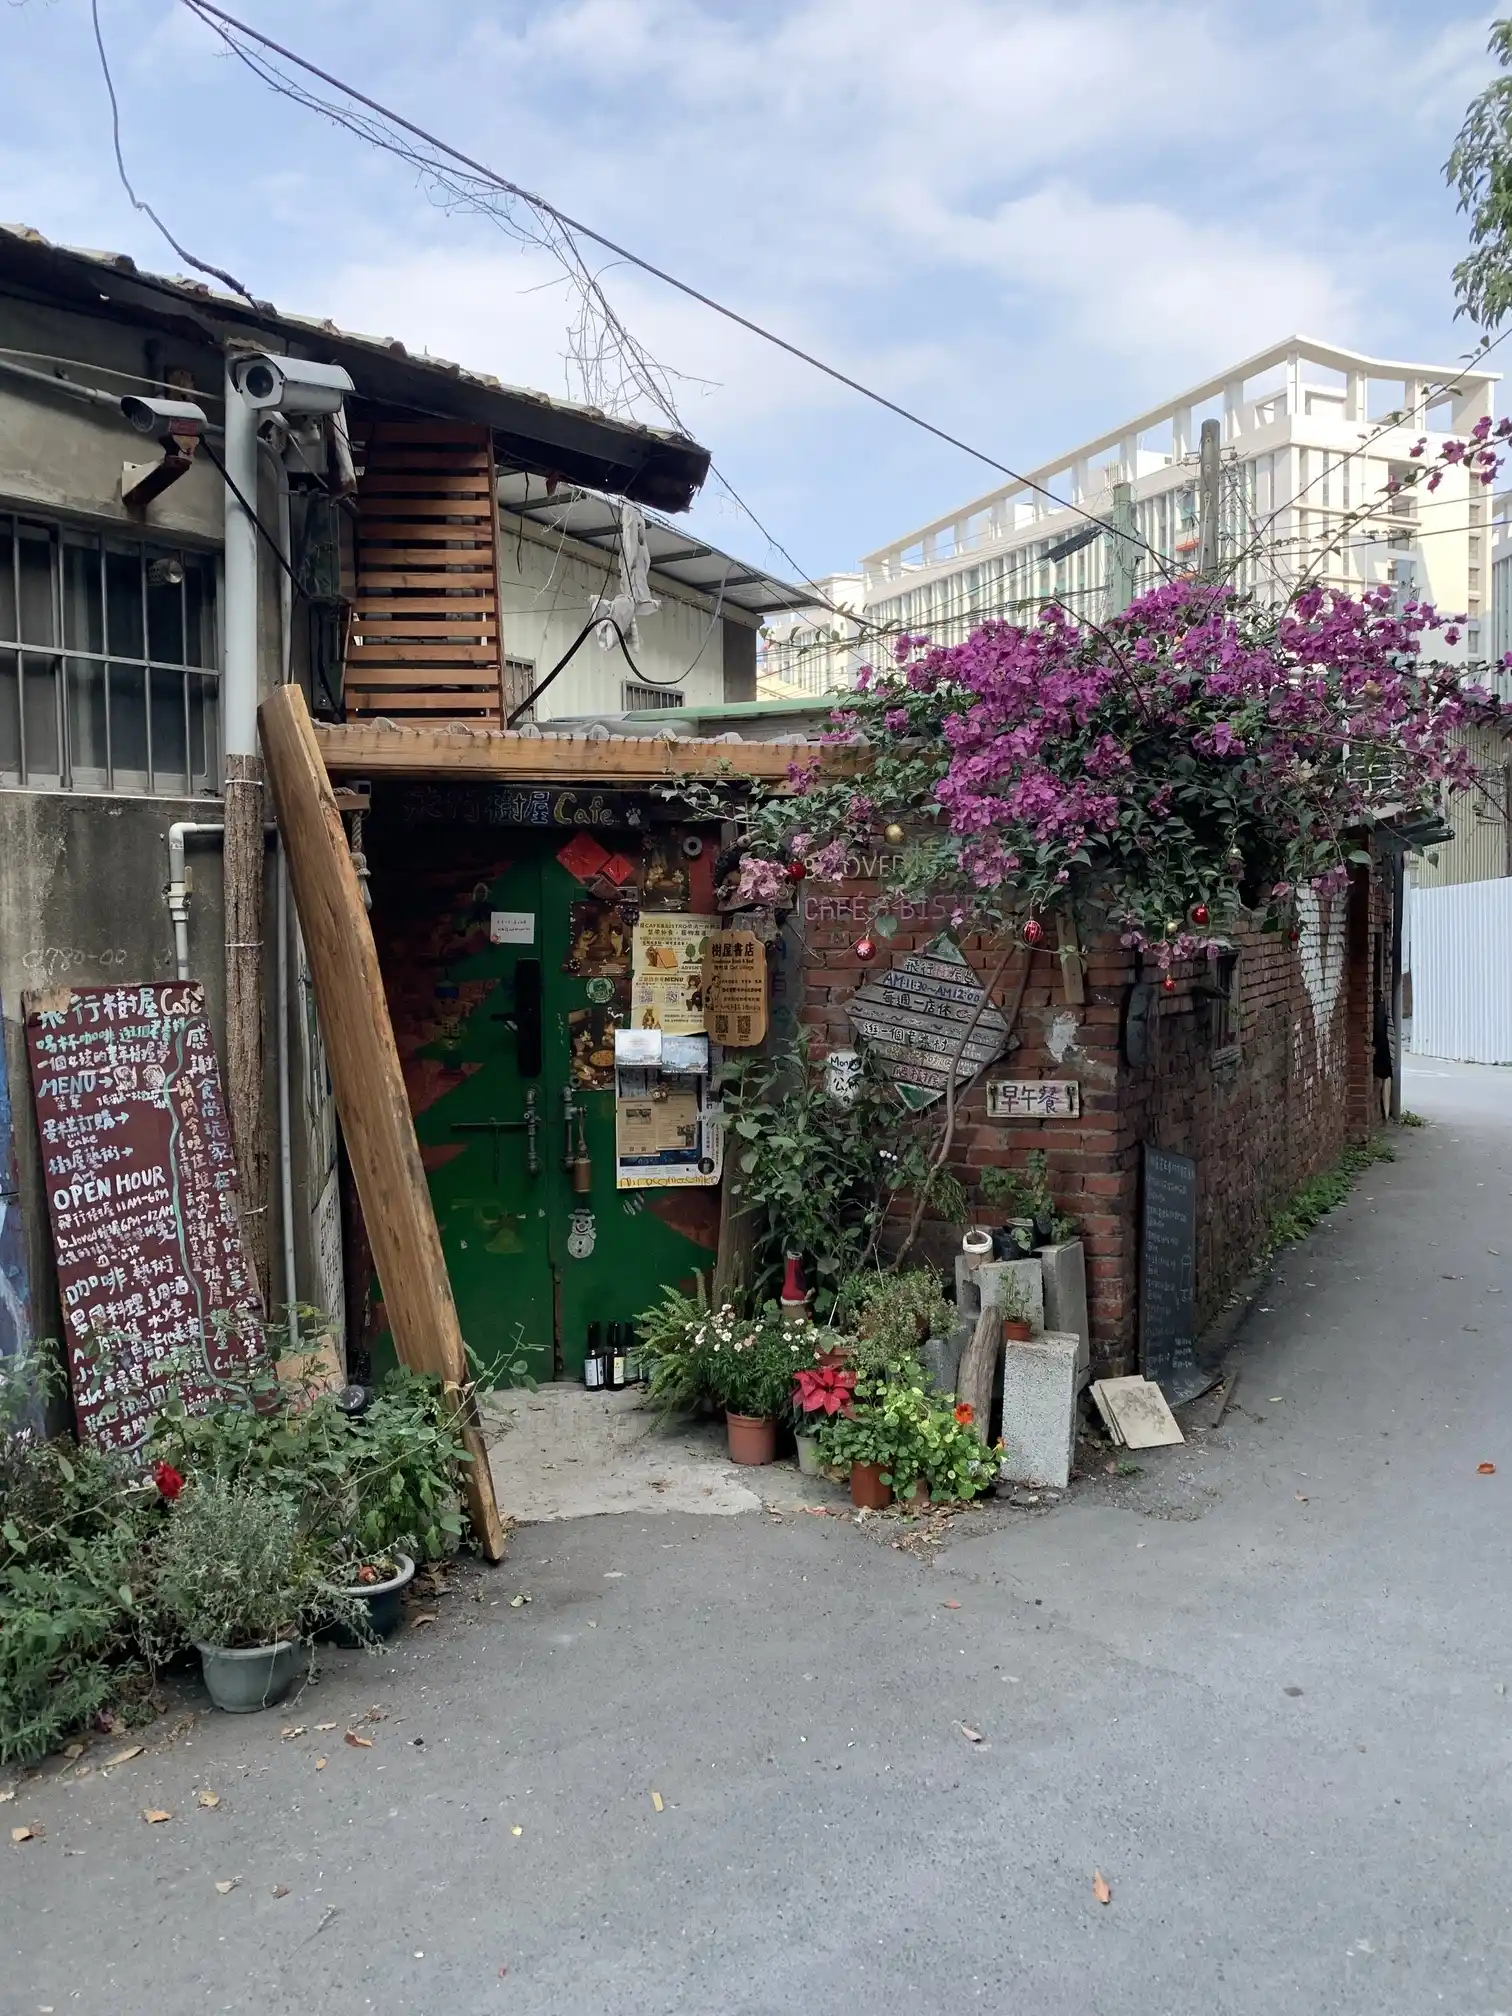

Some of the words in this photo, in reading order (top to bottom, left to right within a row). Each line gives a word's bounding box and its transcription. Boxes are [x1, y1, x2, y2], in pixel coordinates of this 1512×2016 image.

[711, 941, 755, 957] 樹屋書店
[882, 990, 952, 1017] 每週一店休
[38, 1073, 98, 1098] MENU
[54, 1178, 112, 1211] OPEN
[116, 1166, 166, 1196] HOUR
